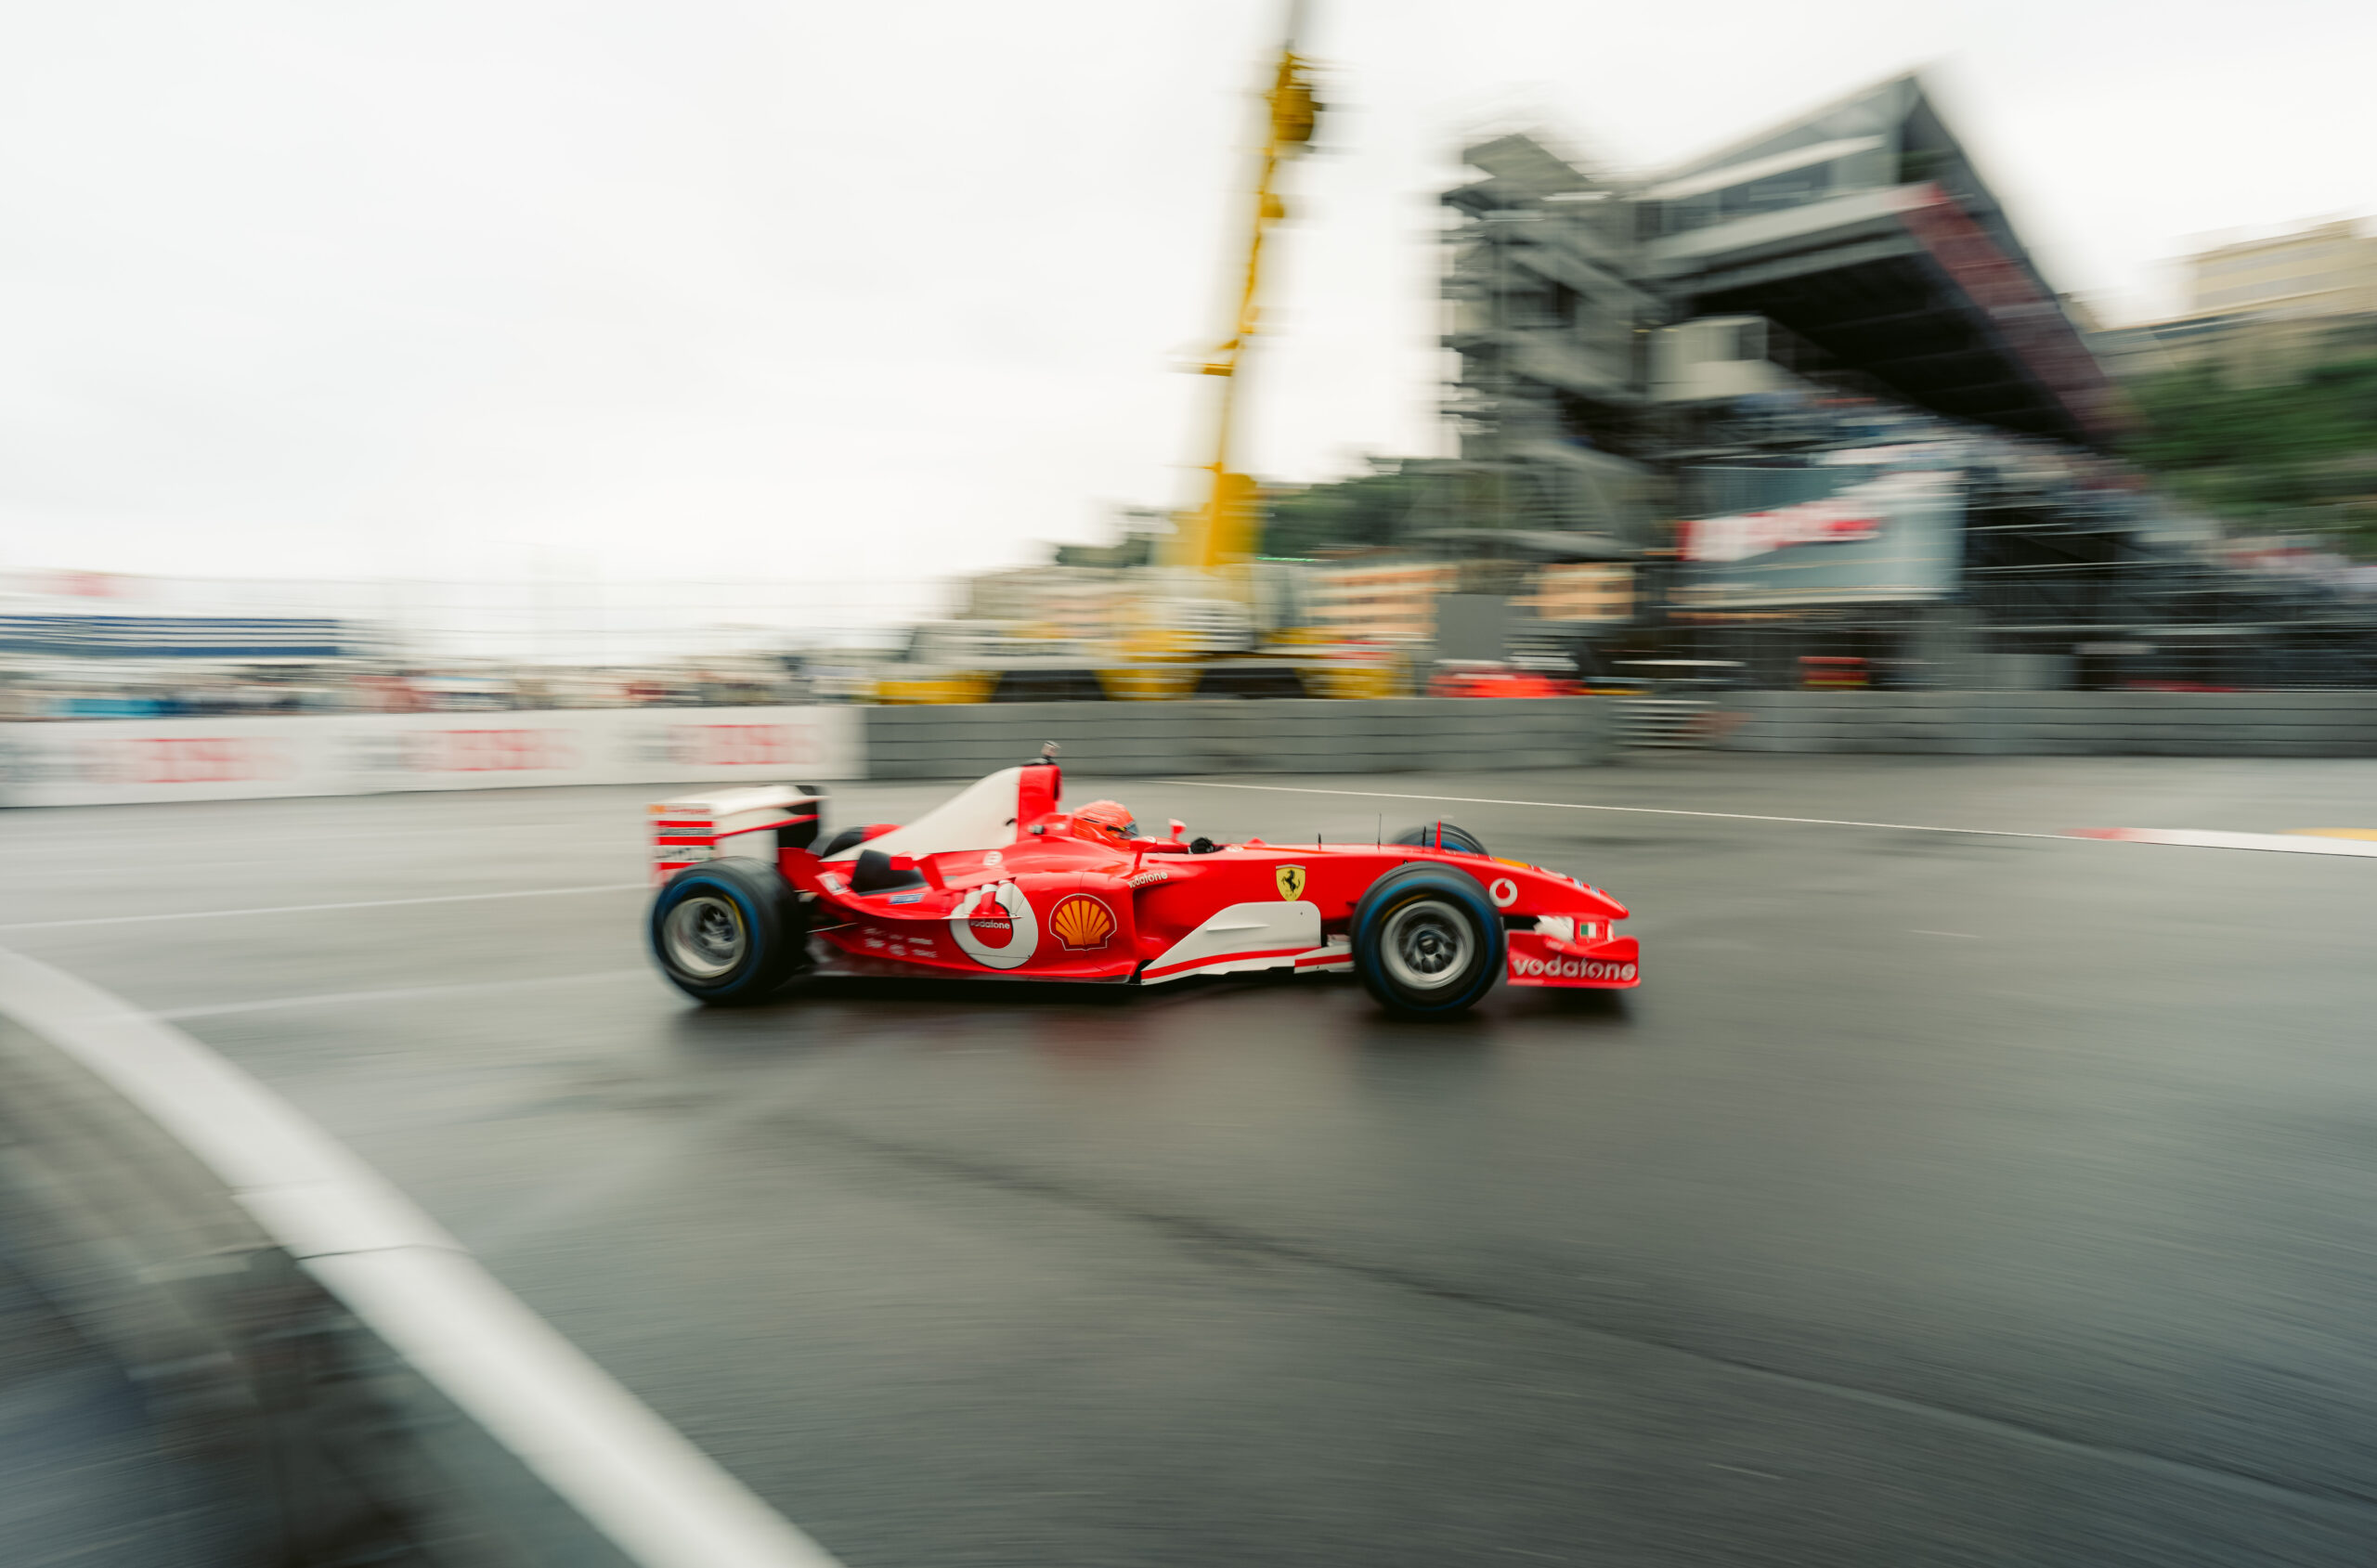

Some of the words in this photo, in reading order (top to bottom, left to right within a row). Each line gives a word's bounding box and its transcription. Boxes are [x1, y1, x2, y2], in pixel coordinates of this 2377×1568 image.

[1127, 872, 1168, 888] vodafone
[970, 919, 1010, 929] vodafone
[1513, 955, 1636, 981] vodafone
